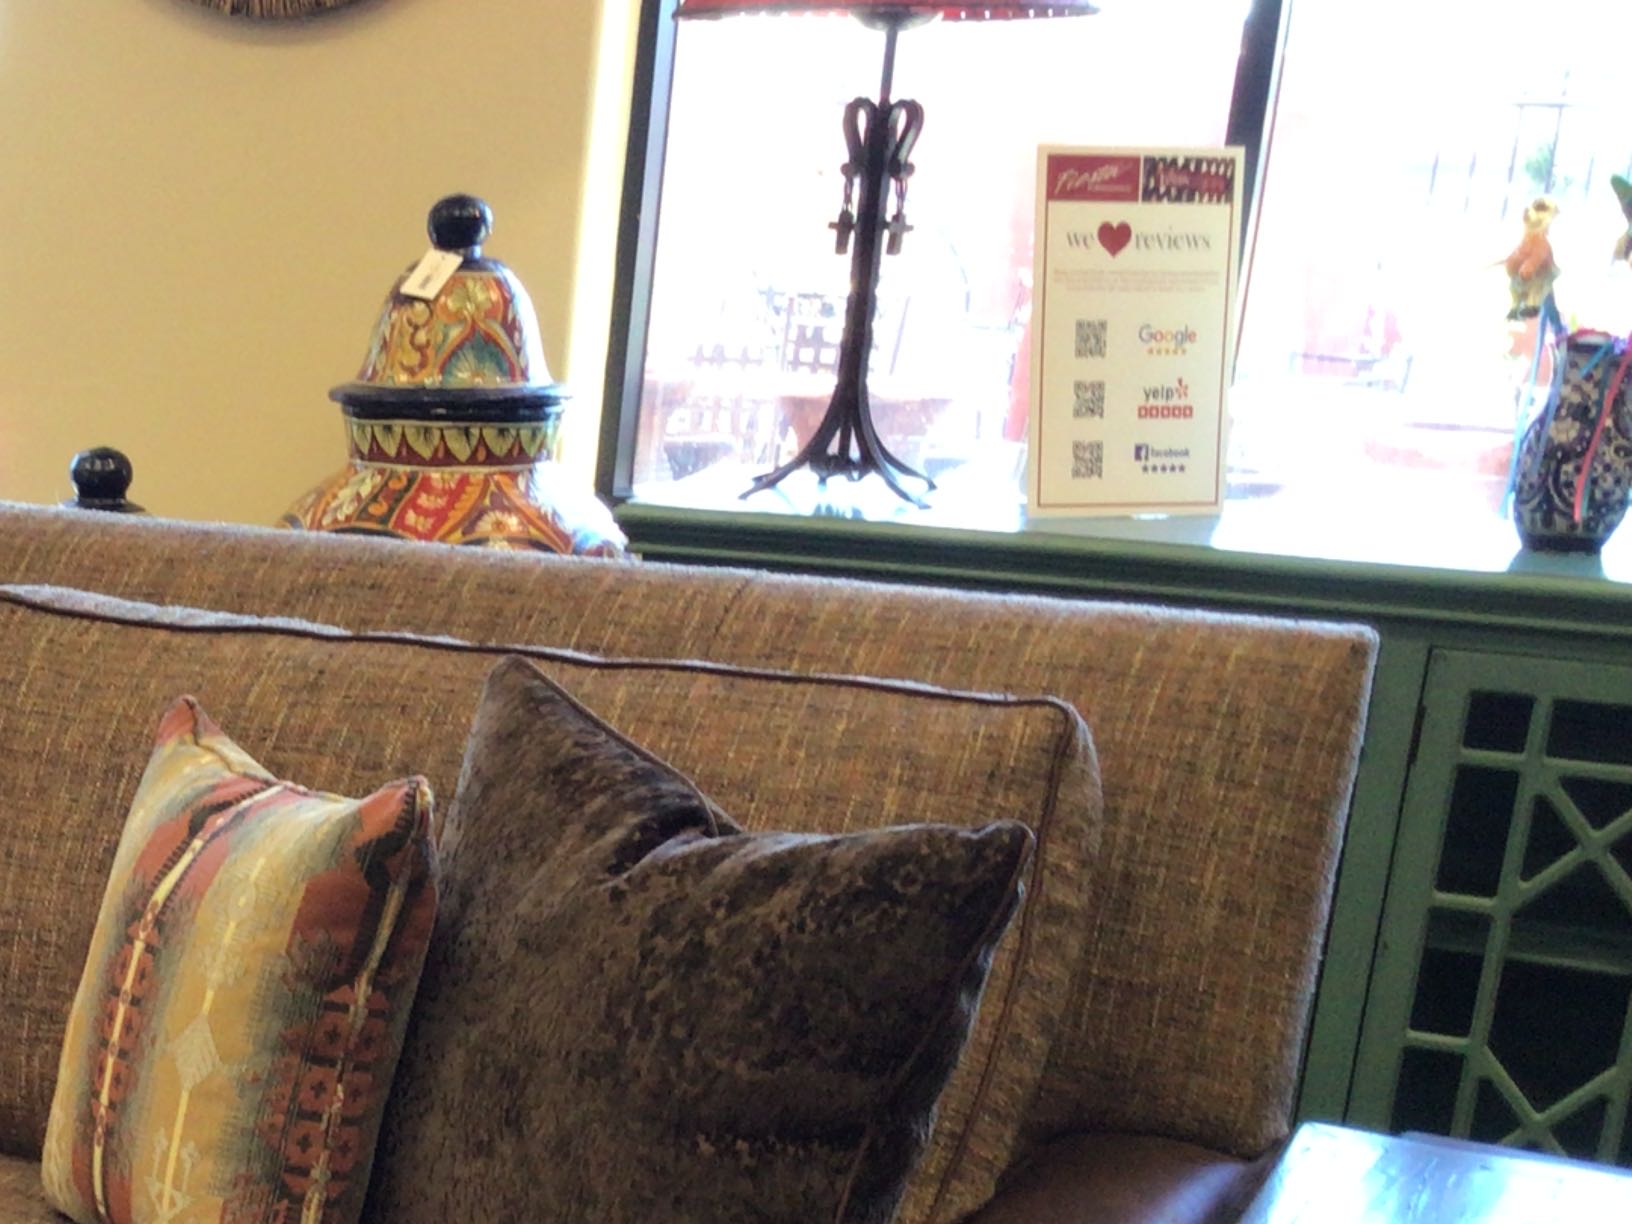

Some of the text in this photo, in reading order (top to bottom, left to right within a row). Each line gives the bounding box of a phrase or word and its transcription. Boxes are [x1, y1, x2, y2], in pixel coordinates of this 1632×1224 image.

[1066, 227, 1211, 250] we reviews
[1139, 324, 1197, 346] Google
[1143, 385, 1174, 402] yelp
[1151, 447, 1190, 458] facebook
